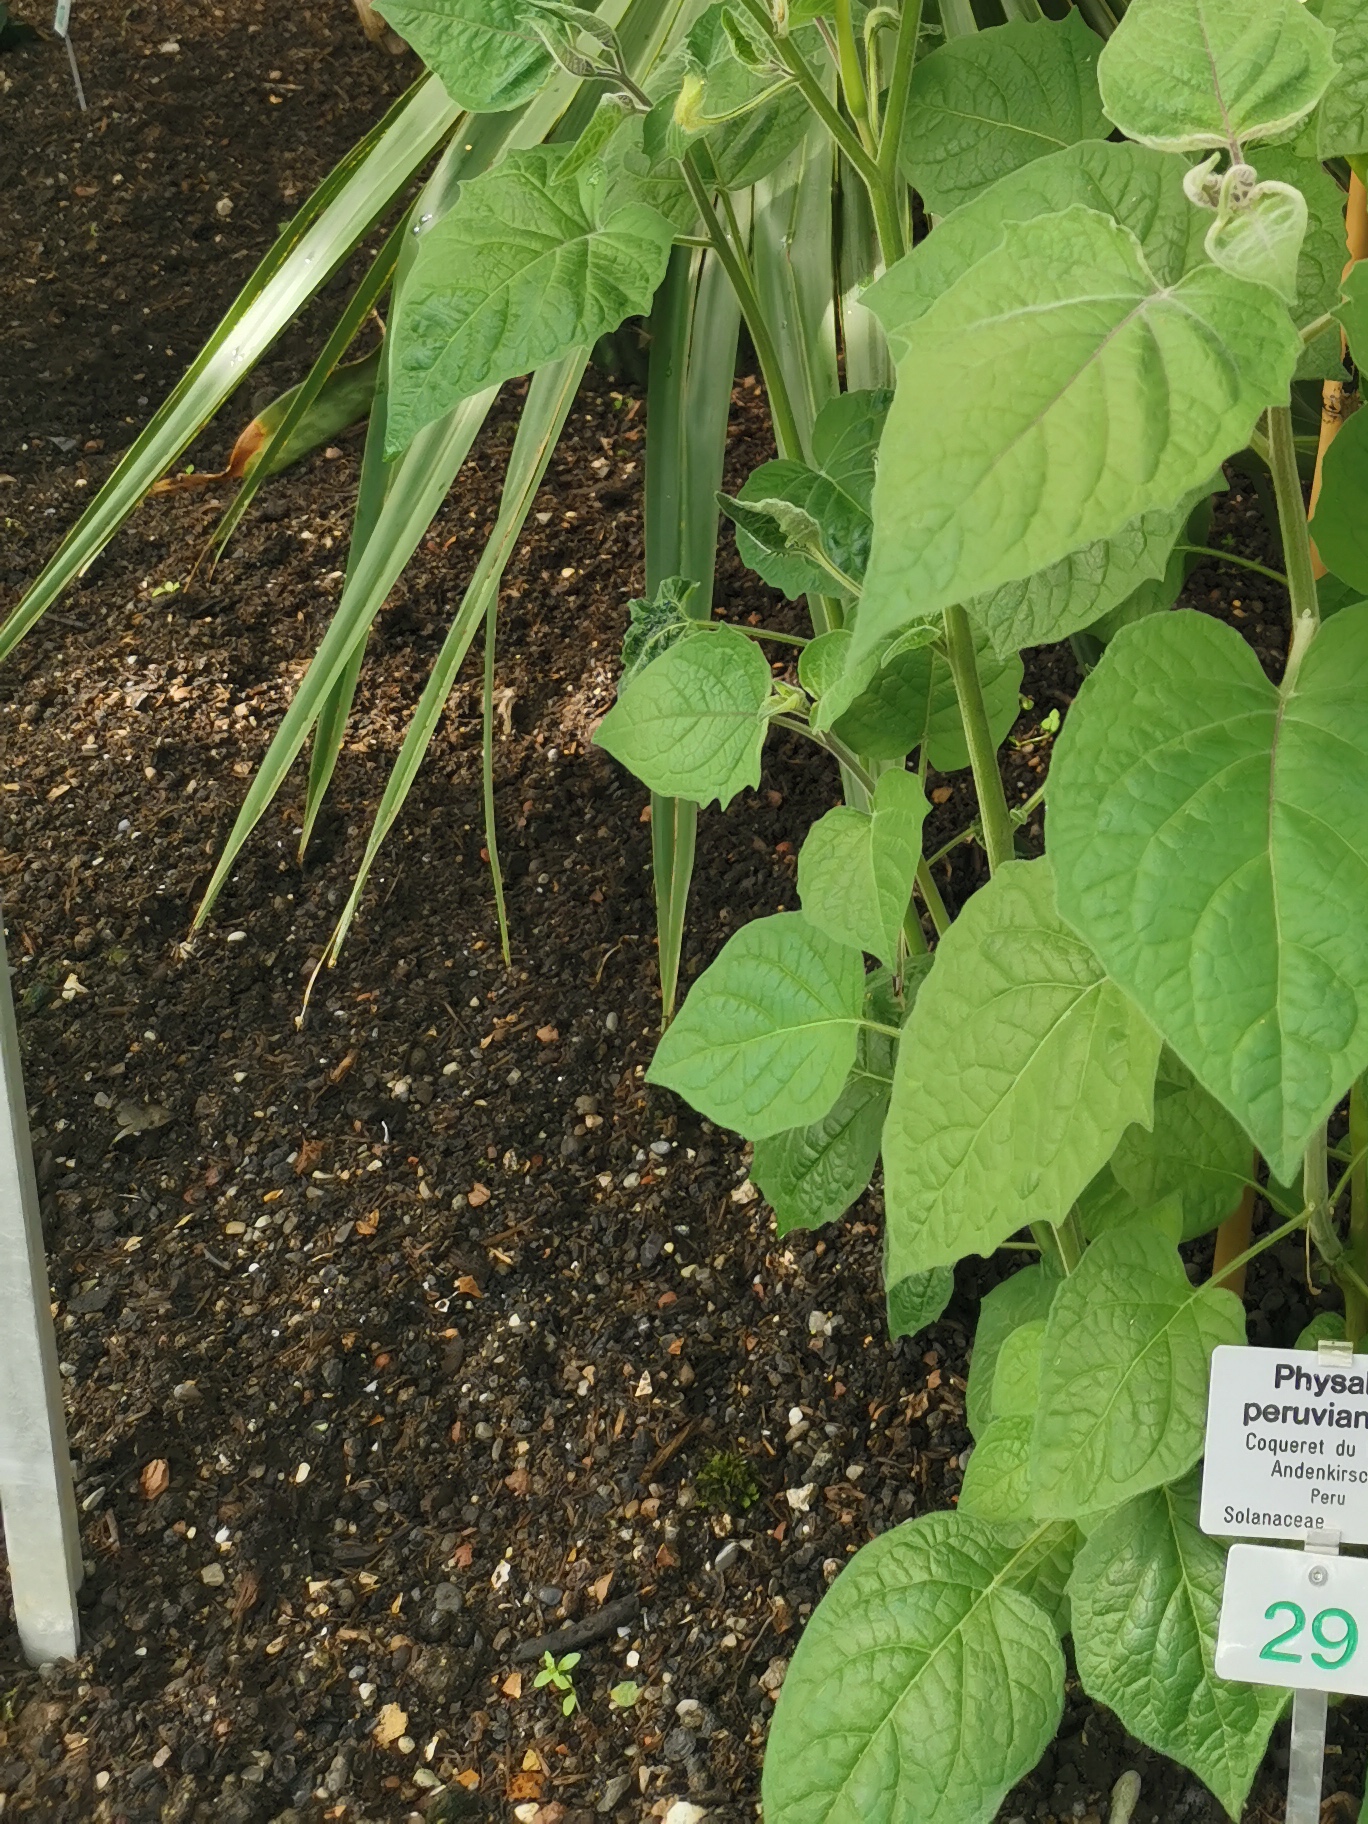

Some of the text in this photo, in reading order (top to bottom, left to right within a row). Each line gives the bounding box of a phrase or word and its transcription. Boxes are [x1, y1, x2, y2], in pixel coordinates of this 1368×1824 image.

[1246, 1432, 1324, 1456] Coqueret
[1336, 1439, 1355, 1457] du
[1311, 1488, 1345, 1506] Peru
[1224, 1506, 1324, 1530] Solanaceae
[1259, 1600, 1358, 1669] 29
